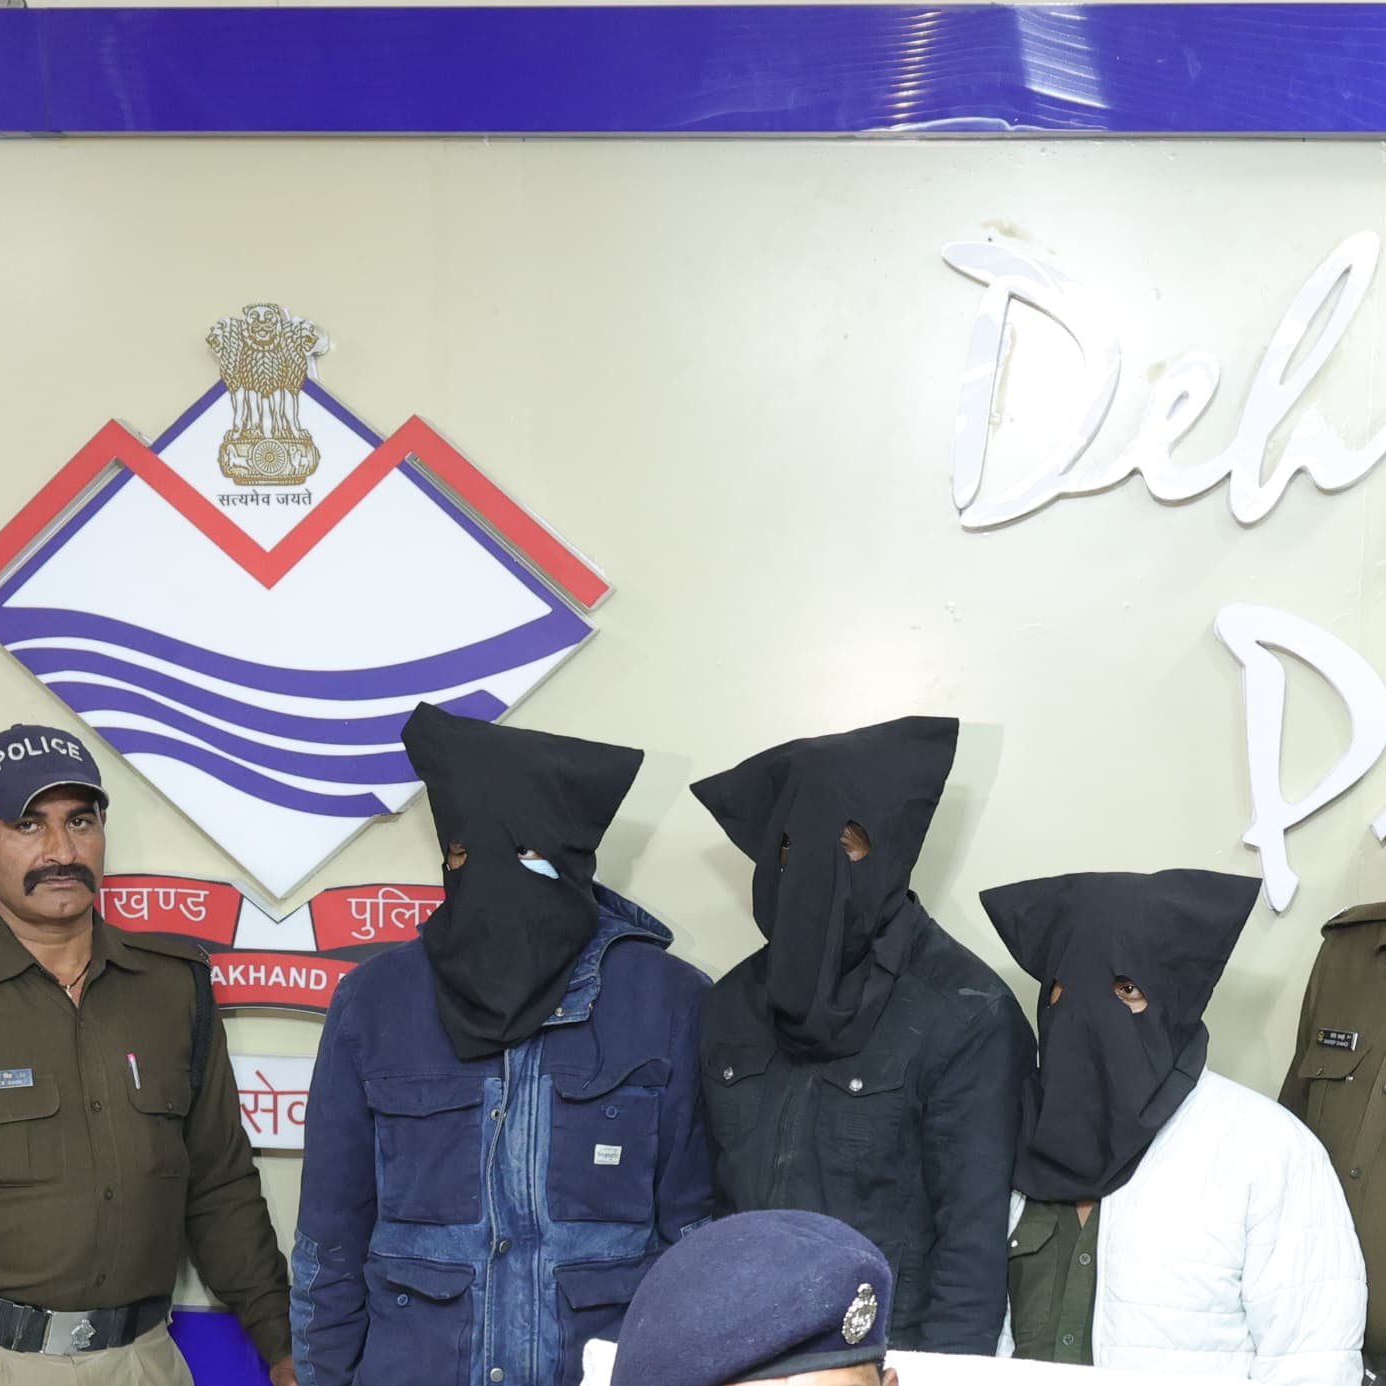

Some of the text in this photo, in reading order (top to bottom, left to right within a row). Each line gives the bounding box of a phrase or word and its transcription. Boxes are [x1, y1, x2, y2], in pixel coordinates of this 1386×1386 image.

[217, 487, 312, 506] सत्यमेव जयते
[99, 888, 209, 922] ाखण्ड
[210, 964, 328, 991] AKHAND
